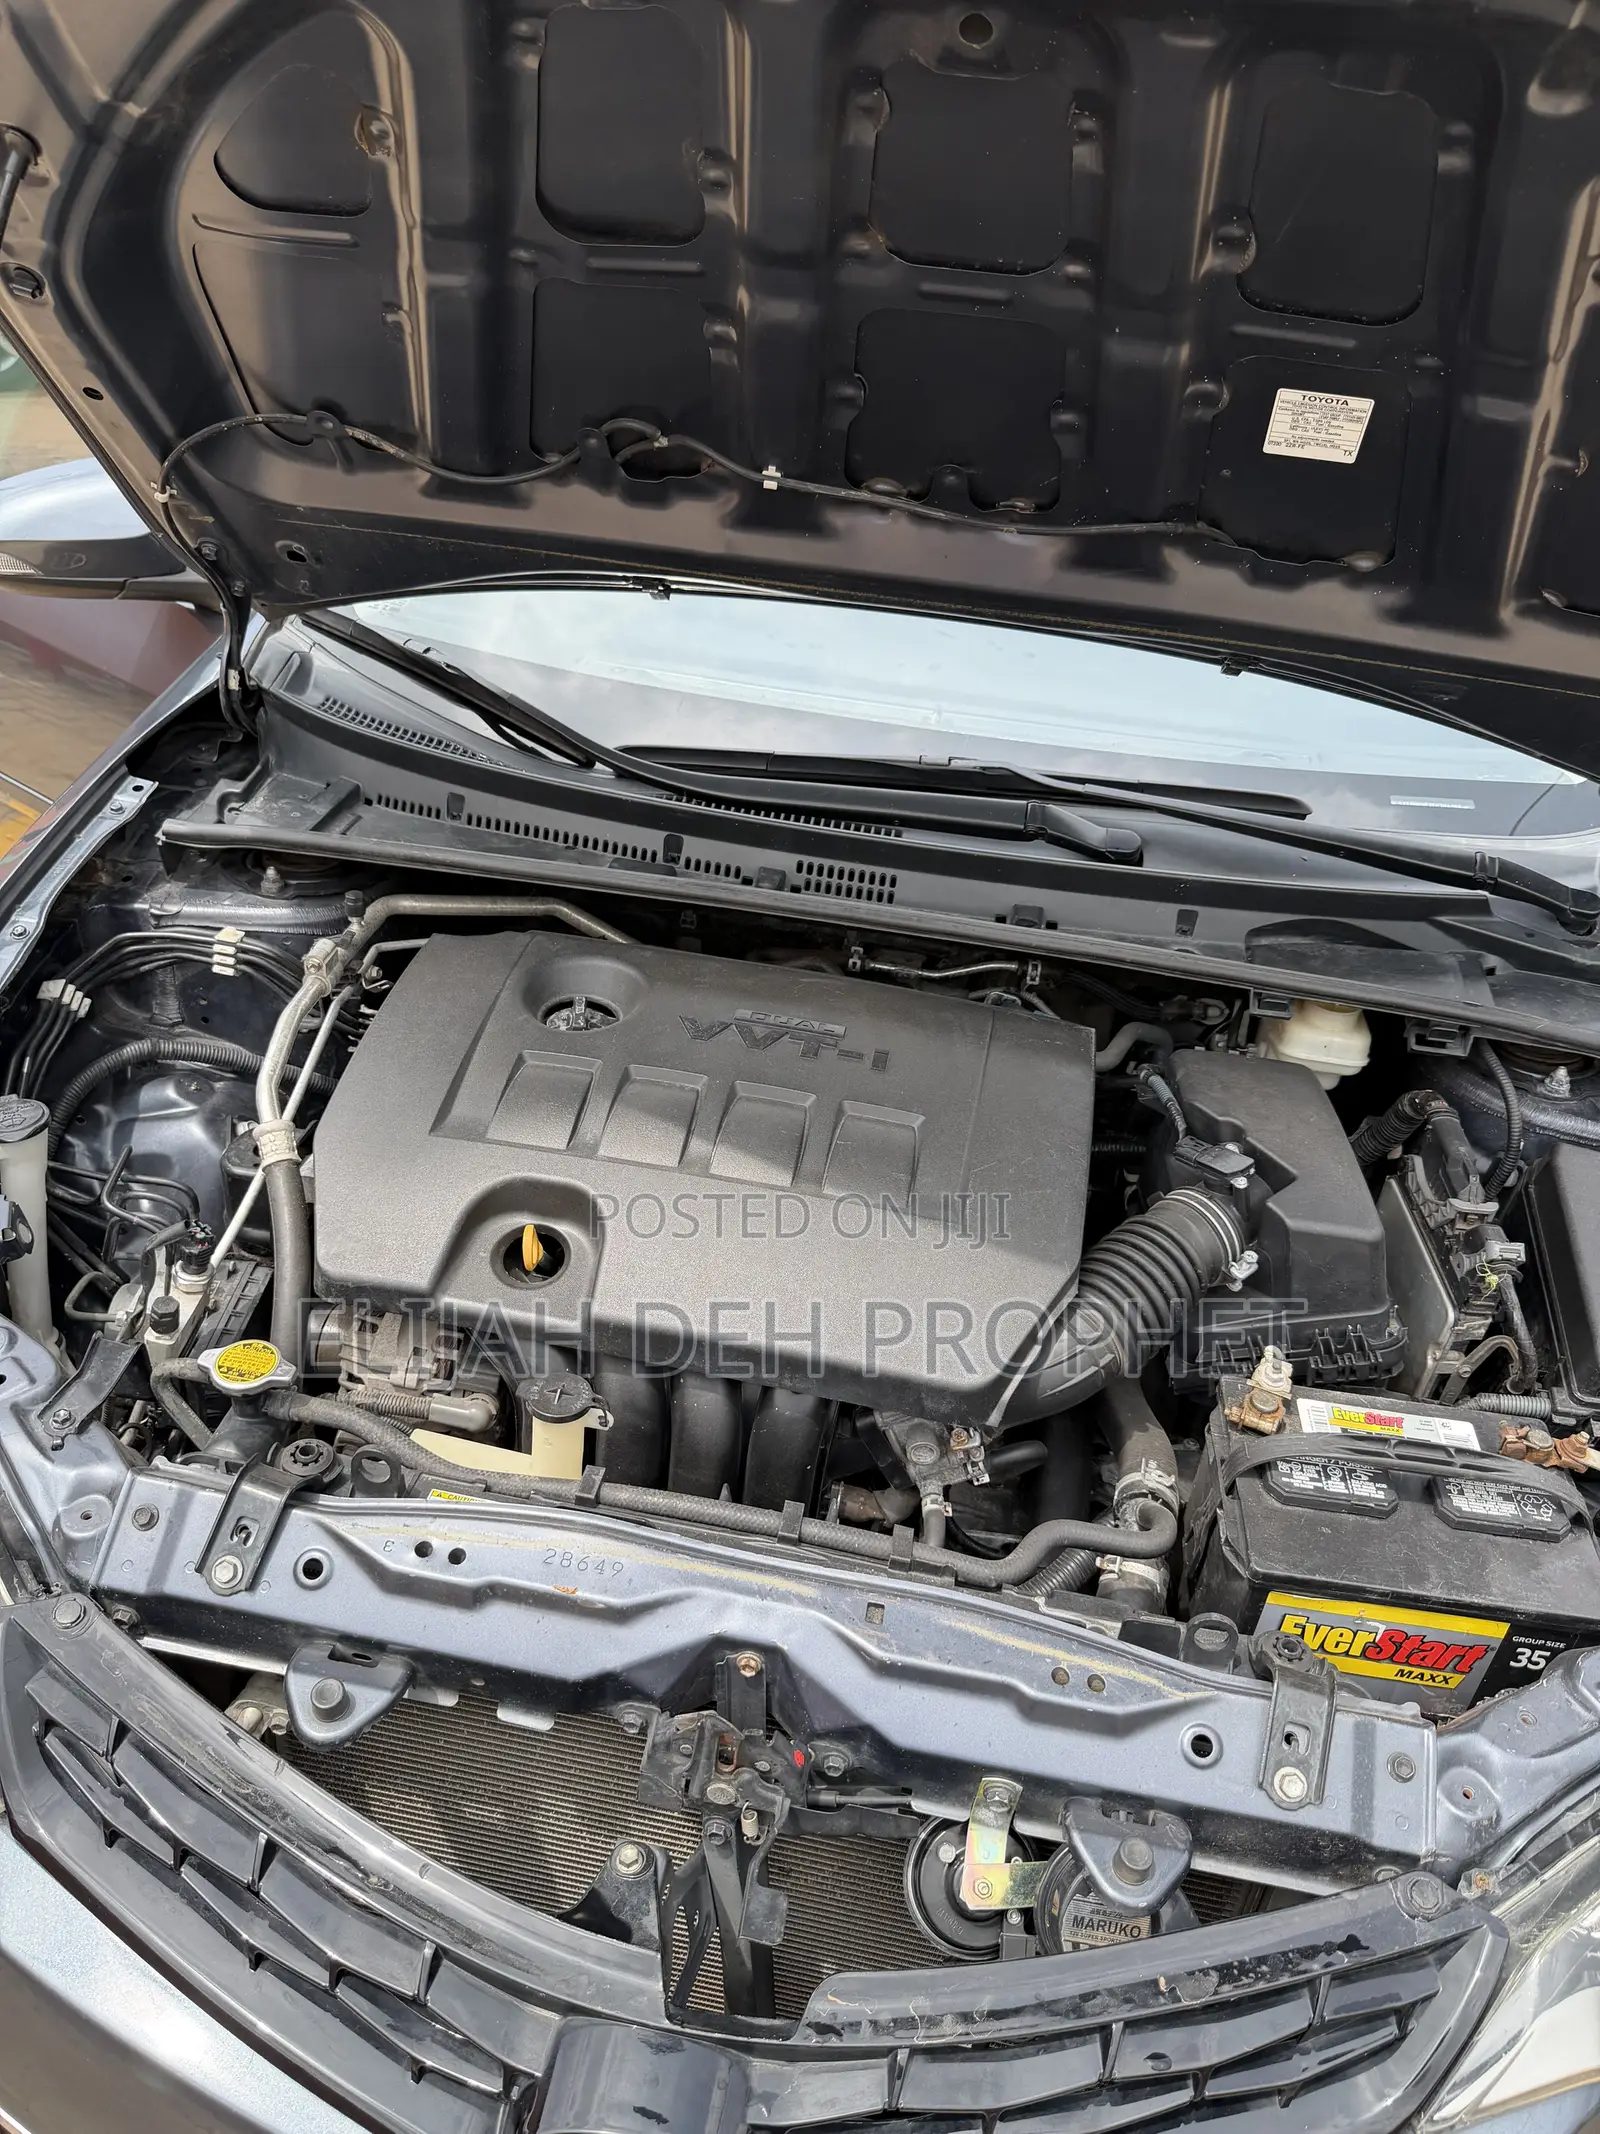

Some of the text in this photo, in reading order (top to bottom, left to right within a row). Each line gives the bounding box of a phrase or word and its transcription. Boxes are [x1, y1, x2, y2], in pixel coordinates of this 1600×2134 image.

[1301, 395, 1349, 407] TOYOTA
[1343, 449, 1354, 457] TX
[1332, 1407, 1404, 1429] EverStart
[543, 1548, 624, 1578] 28649
[1278, 1613, 1490, 1673] EverStart
[1512, 1634, 1567, 1649] GROUP SIZE
[1509, 1648, 1550, 1670] 35
[1394, 1667, 1455, 1686] MAXX
[1072, 1914, 1141, 1938] MARUKO
